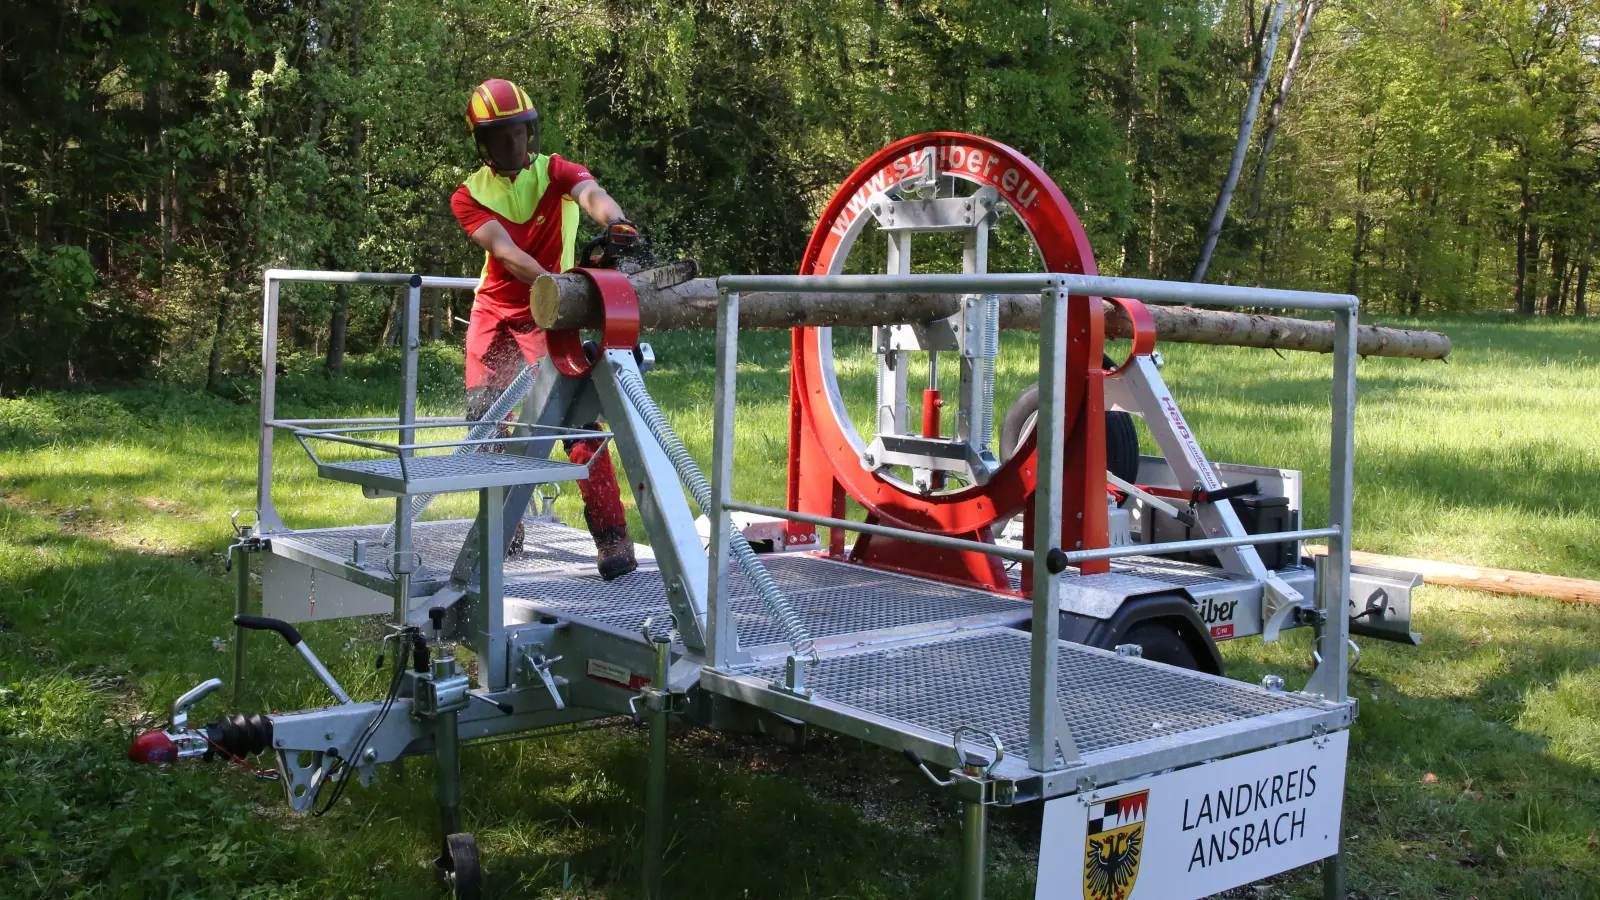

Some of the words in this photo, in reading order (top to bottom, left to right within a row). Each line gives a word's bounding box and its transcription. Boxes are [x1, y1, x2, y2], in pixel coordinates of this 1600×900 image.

[831, 138, 1039, 239] www.stiber.eu
[1182, 765, 1317, 831] LANDKREIS
[1187, 807, 1306, 872] ANSBACH
